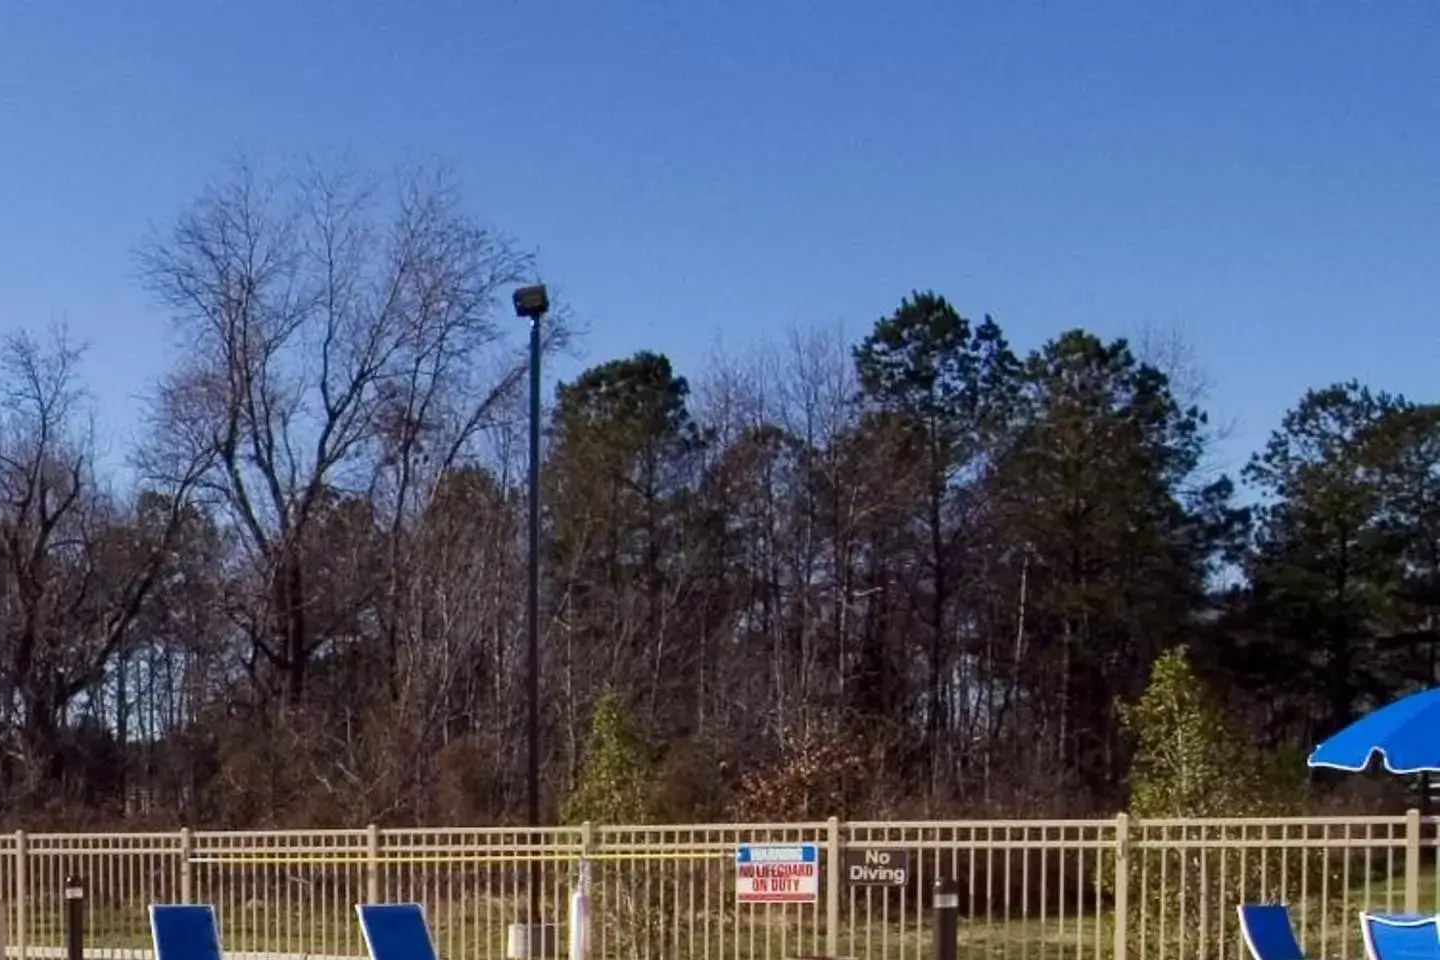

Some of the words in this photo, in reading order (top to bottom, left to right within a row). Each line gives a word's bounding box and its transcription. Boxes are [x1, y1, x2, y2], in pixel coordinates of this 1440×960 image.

[865, 850, 890, 864] No
[739, 865, 755, 878] NO
[756, 864, 813, 878] LIFEGUARD
[850, 865, 905, 884] Diving
[752, 878, 767, 891] ON
[771, 878, 800, 891] DUTY
